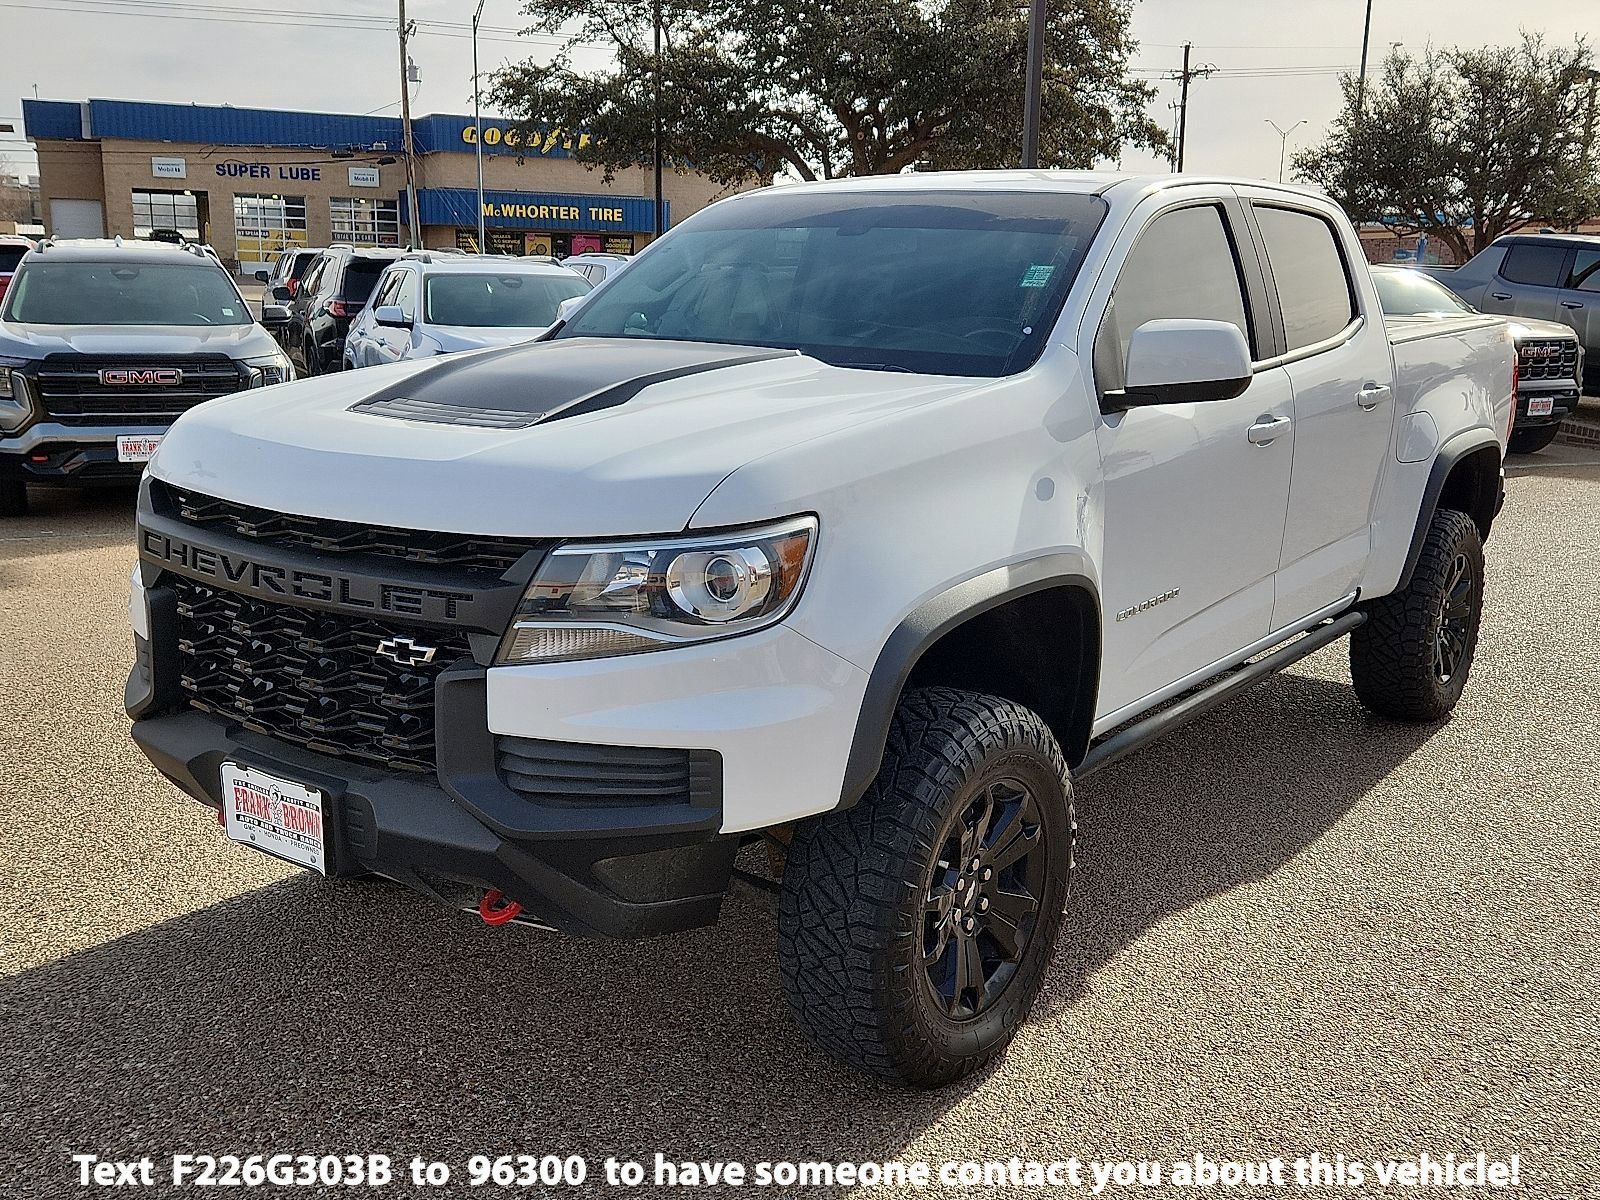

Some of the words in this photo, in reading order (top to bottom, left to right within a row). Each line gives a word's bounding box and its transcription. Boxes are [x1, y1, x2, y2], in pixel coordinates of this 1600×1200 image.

[215, 163, 271, 179] SUPER
[279, 166, 321, 181] LUBE
[482, 203, 580, 220] McWHORTER
[589, 207, 623, 222] TIRE
[1521, 346, 1560, 358] GMC
[105, 370, 177, 384] GMC
[143, 530, 474, 620] CHEVROLET
[1115, 586, 1181, 622] COLORADO
[233, 786, 272, 822] FRANK
[282, 802, 321, 838] BROWN
[260, 822, 274, 831] AND
